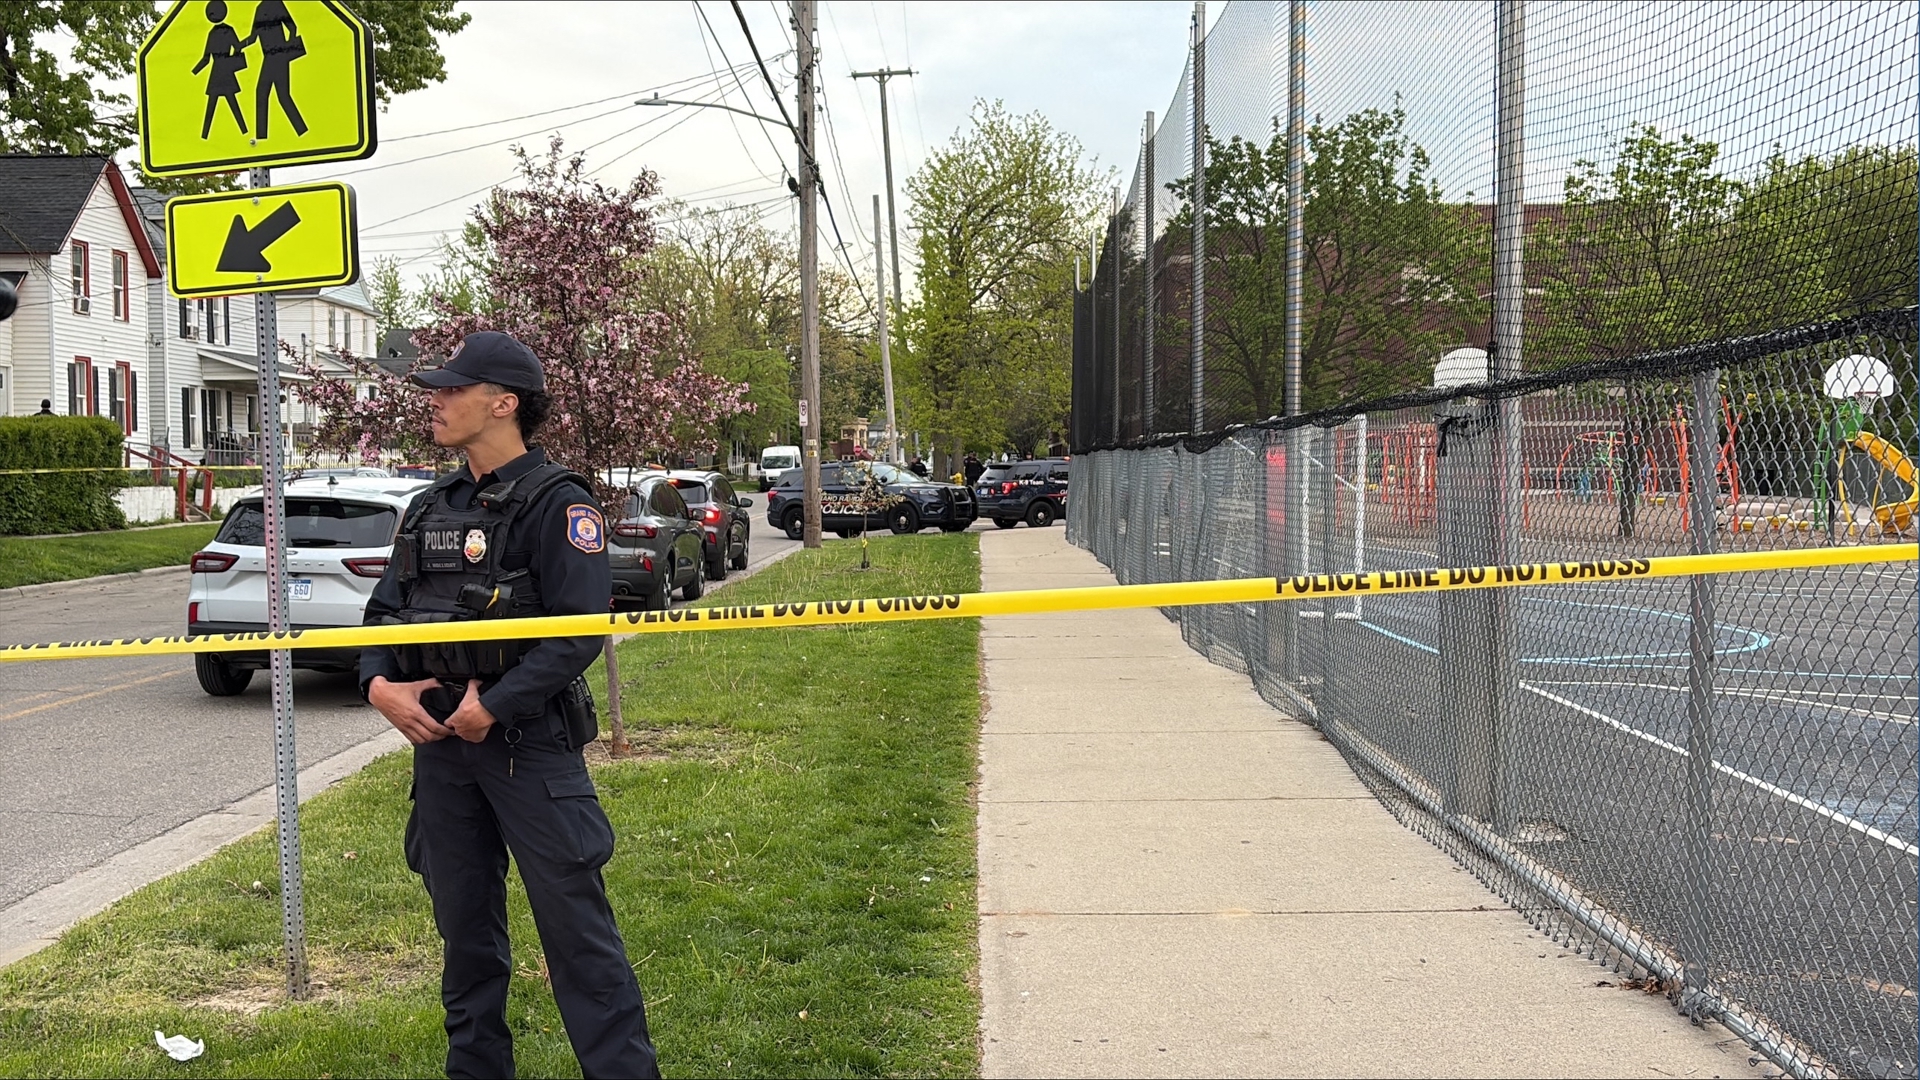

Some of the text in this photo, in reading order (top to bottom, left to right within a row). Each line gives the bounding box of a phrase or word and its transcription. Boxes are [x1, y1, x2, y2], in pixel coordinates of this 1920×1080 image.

[820, 503, 861, 515] OLICE
[424, 530, 460, 550] POLICE
[574, 536, 599, 549] POLICE
[1276, 558, 1651, 594] POLICE LINE DO NOT CROSS
[708, 605, 764, 620] LINE
[773, 602, 808, 617] DO
[817, 599, 865, 615] NOT
[876, 594, 961, 613] CROSS
